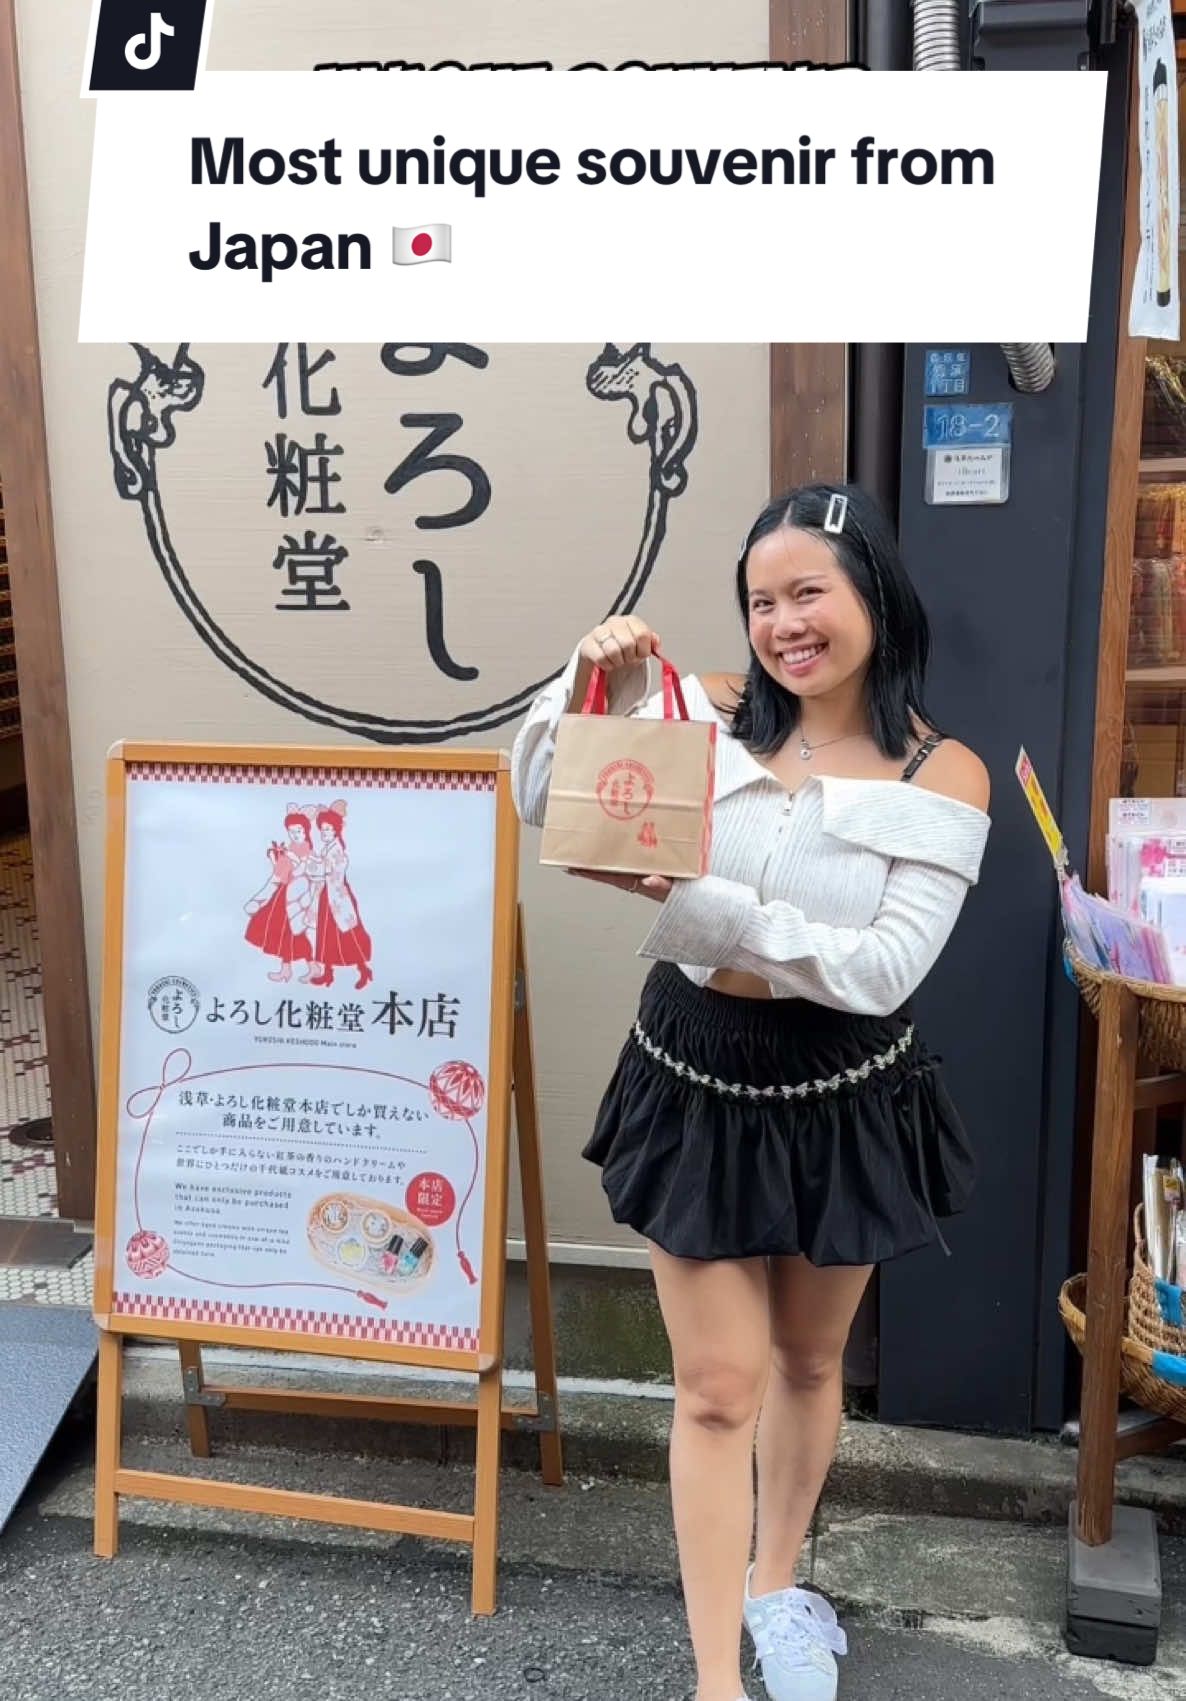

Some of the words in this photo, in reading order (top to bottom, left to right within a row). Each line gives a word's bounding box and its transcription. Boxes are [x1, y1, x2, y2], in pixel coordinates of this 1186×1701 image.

[263, 344, 350, 610] 化粧堂
[206, 990, 461, 1039] よろし化粧堂本店
[223, 1112, 381, 1139] 商品をご用意しています。
